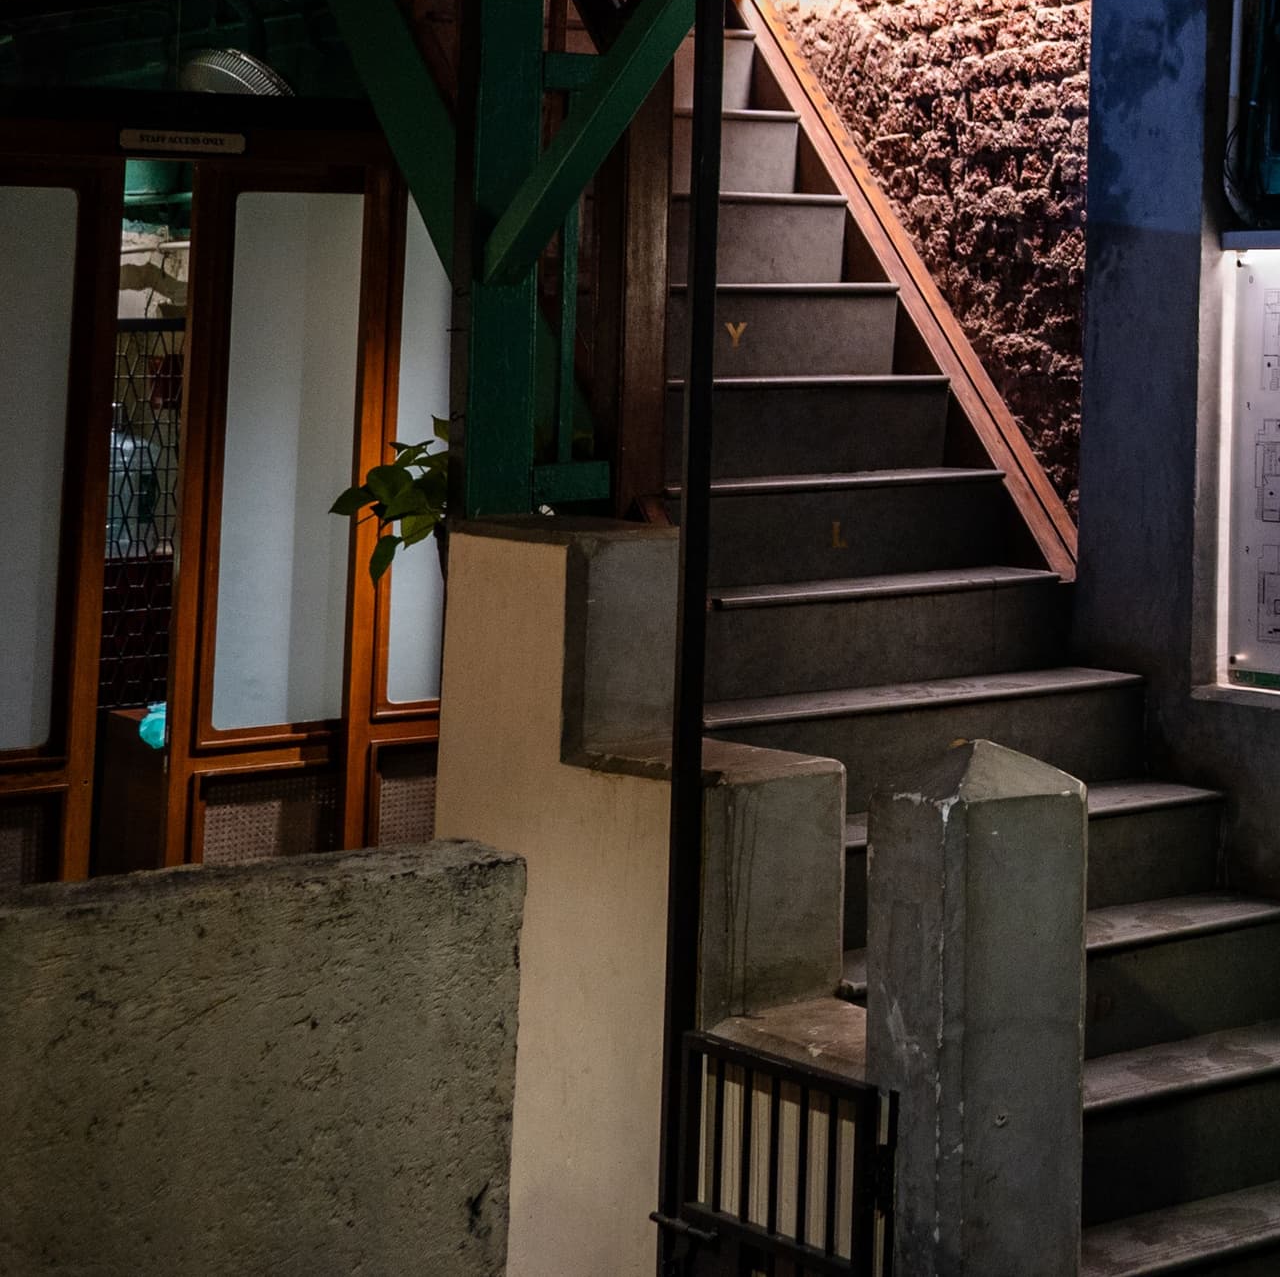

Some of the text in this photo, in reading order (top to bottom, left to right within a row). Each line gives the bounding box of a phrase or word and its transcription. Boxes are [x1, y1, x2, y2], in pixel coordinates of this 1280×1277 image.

[139, 133, 225, 147] STAFF ACCESS ONLY
[724, 321, 748, 350] Y
[832, 520, 848, 550] L
